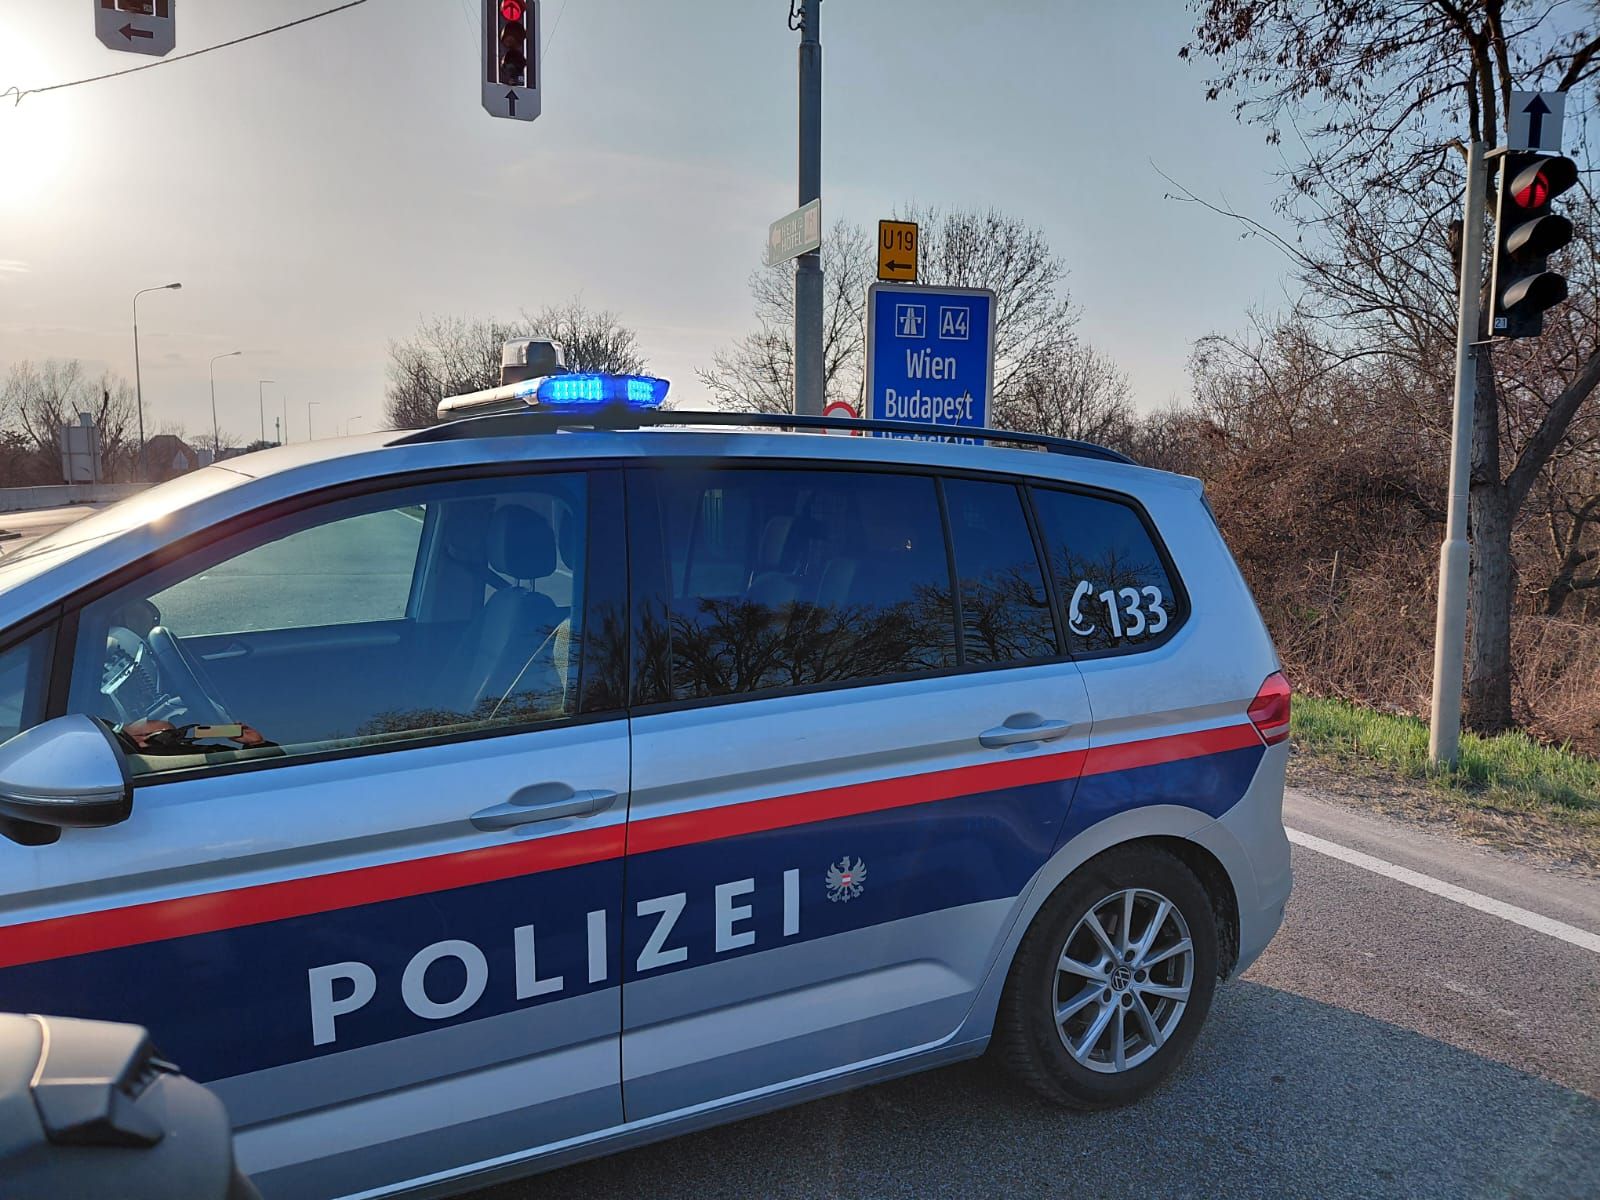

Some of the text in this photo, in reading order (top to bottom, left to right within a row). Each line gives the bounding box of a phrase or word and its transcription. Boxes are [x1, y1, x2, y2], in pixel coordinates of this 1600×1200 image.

[942, 311, 967, 335] A4
[906, 347, 957, 380] Wien
[885, 388, 974, 424] Budapest
[1098, 585, 1168, 638] 133
[308, 868, 800, 1046] POLIZEI
